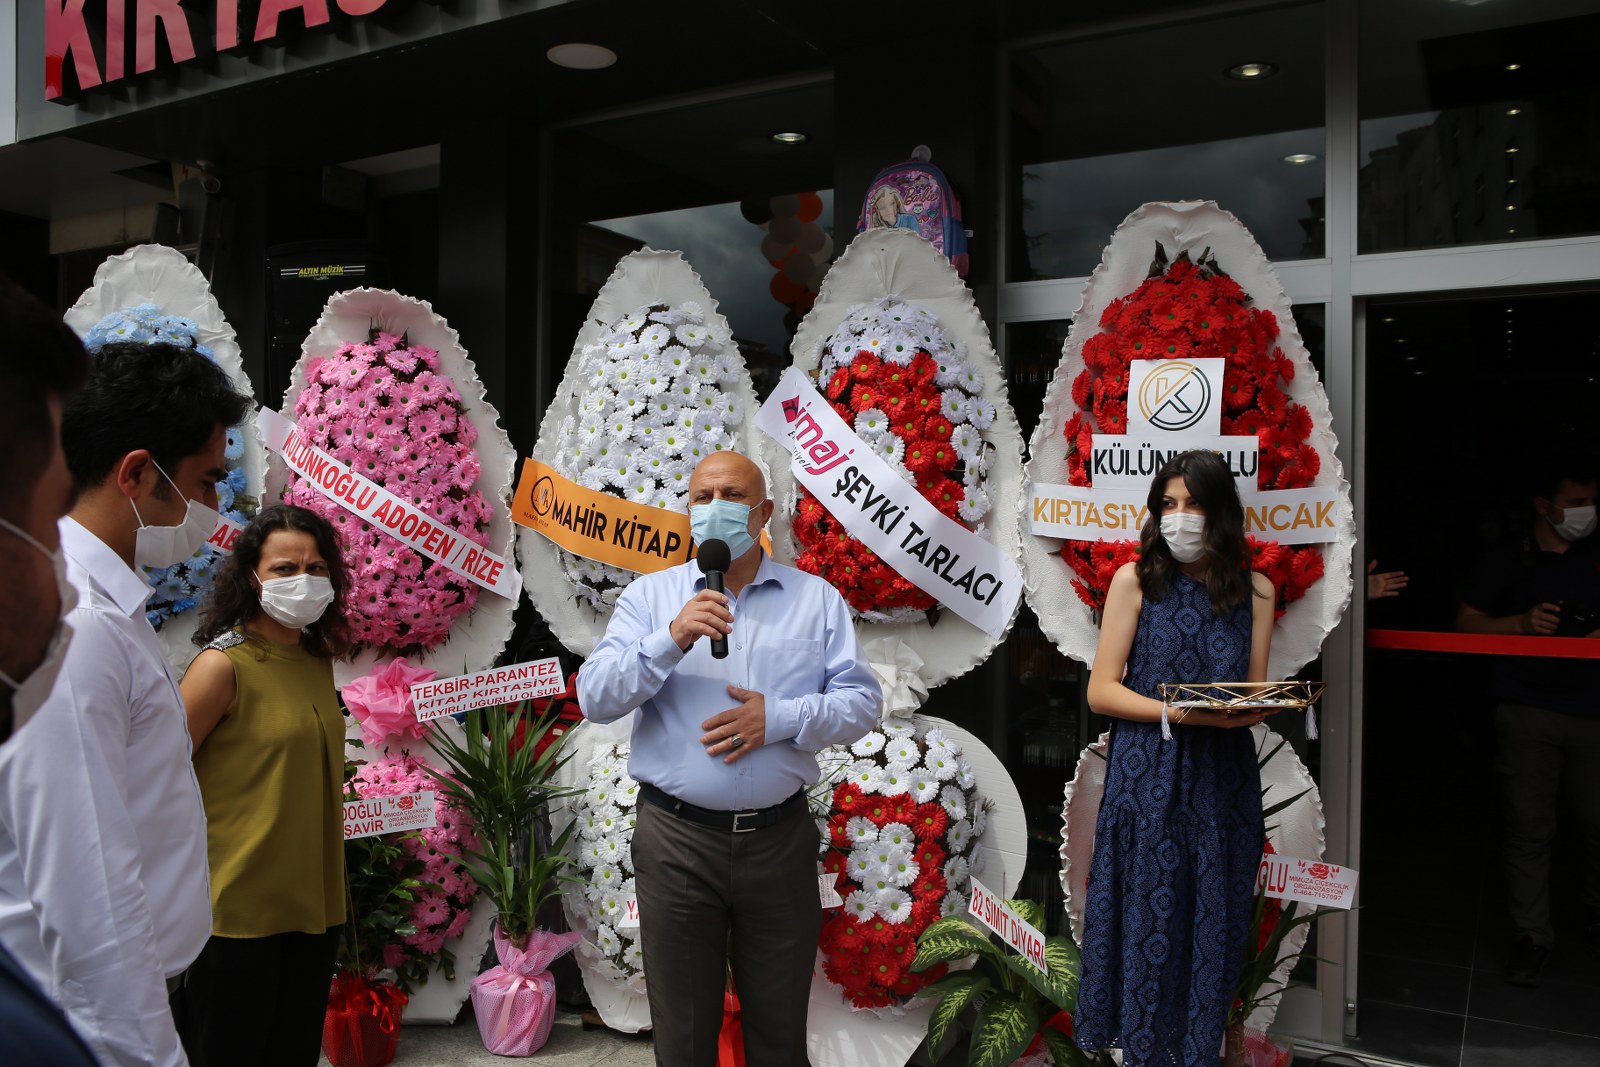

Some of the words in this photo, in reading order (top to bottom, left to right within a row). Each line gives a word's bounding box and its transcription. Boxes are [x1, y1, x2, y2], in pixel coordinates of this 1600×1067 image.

[45, 0, 387, 101] KIRTA
[904, 187, 939, 205] Barbie
[299, 267, 319, 275] ALTIN
[320, 265, 344, 273] MÜZİK
[551, 496, 608, 542] MAHİR
[612, 515, 681, 559] KİTAP
[1243, 501, 1335, 532] NCAK
[371, 498, 456, 560] ADOPEN
[463, 549, 504, 586] RİZE
[832, 466, 909, 535] ŞEVKİ
[900, 521, 1003, 606] TARLACI
[414, 662, 557, 700] TEKBİR-PARANTEZ
[418, 693, 468, 711] KİTAP
[472, 676, 559, 699] KIRTASİYE
[420, 704, 466, 720] HAYIRLI
[469, 694, 518, 709] UĞURLU
[521, 687, 561, 699] OLSUN
[1293, 889, 1342, 901] 0-464-7157097
[972, 886, 984, 917] 82
[985, 895, 1009, 938] SİMİT
[1011, 919, 1046, 970] DİYARI
